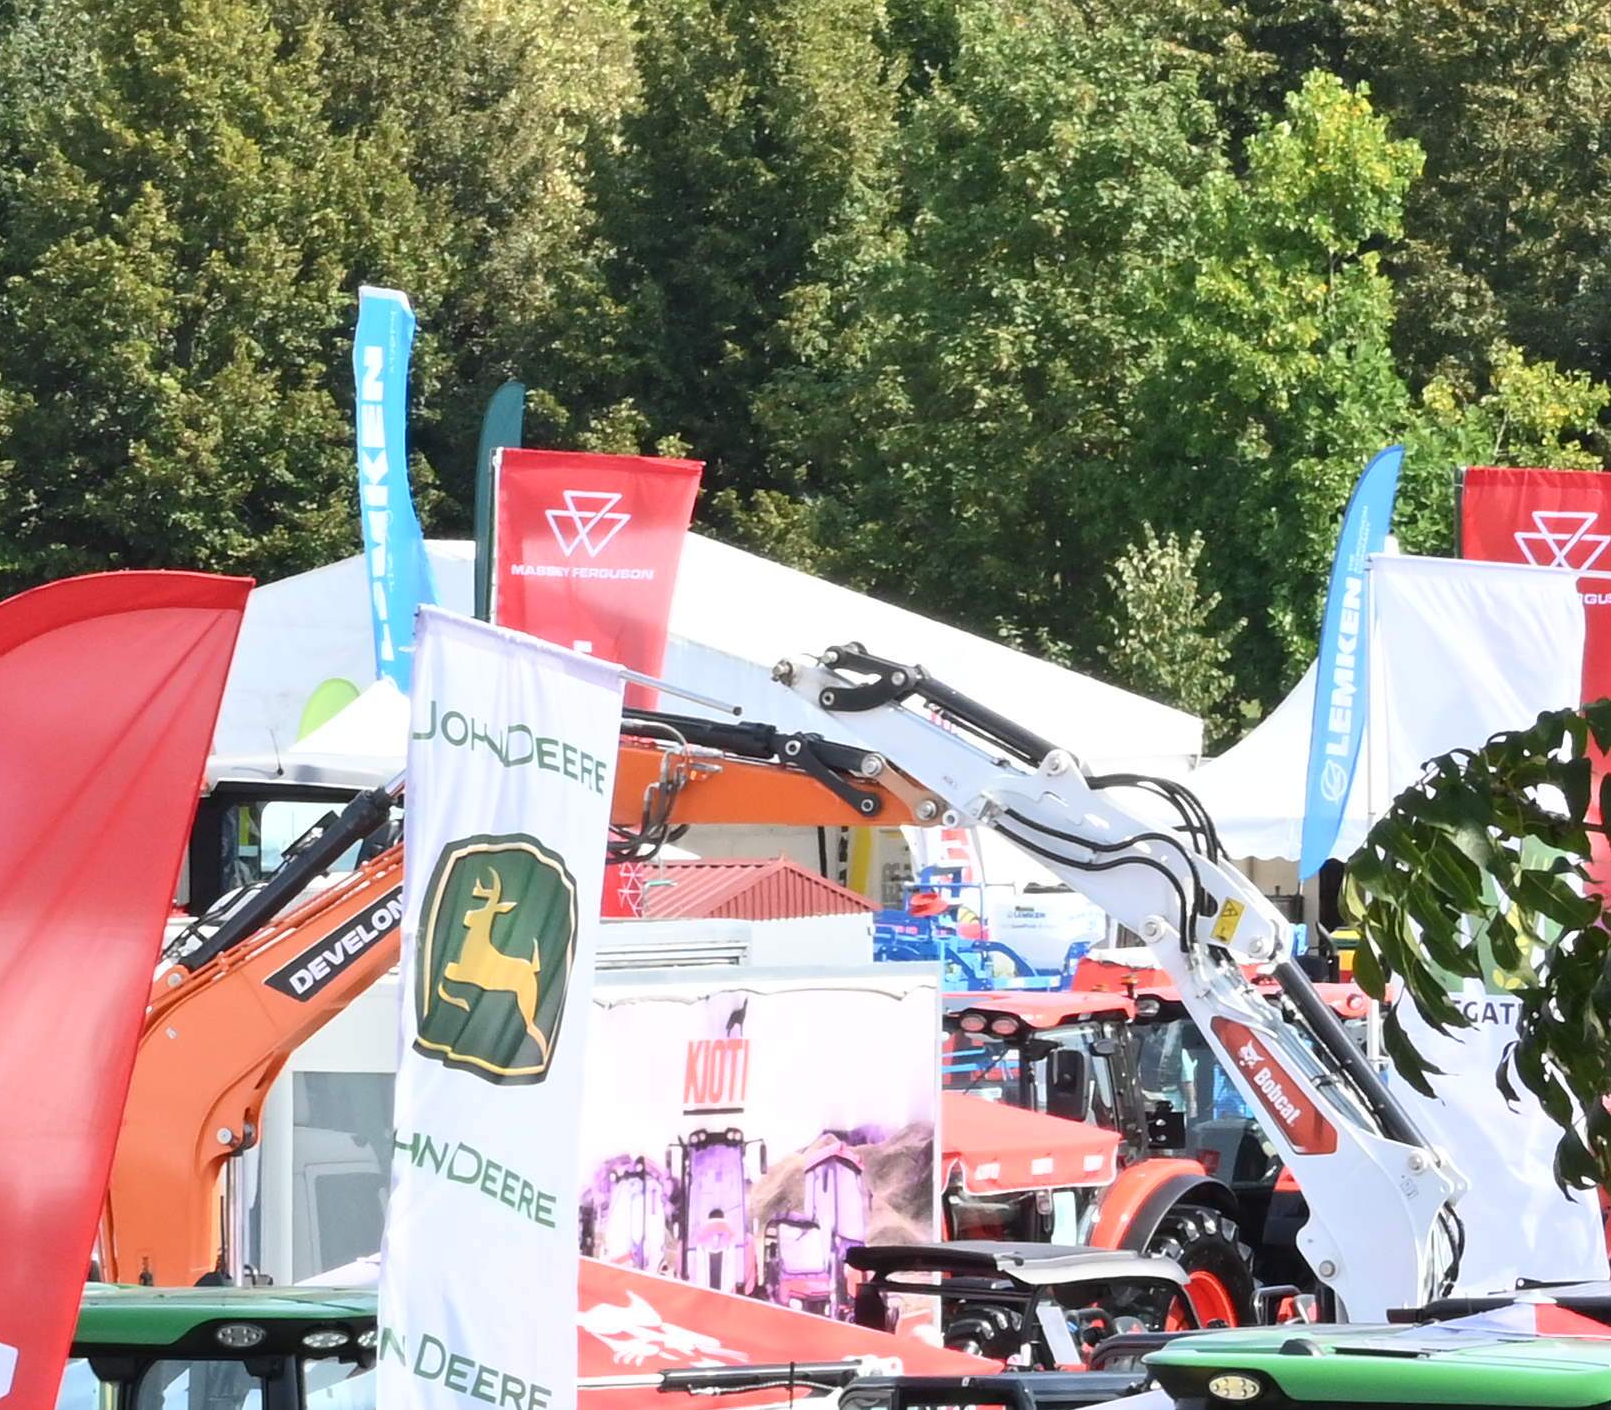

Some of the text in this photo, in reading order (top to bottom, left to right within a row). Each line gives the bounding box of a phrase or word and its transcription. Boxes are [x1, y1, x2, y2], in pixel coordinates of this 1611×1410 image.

[572, 565, 655, 581] FERGUSON
[1325, 576, 1363, 757] LEMKEN
[506, 723, 608, 795] DEERE
[683, 1038, 750, 1104] KIOTI
[1252, 1065, 1300, 1127] Bobcat
[446, 1142, 557, 1229] DEERE
